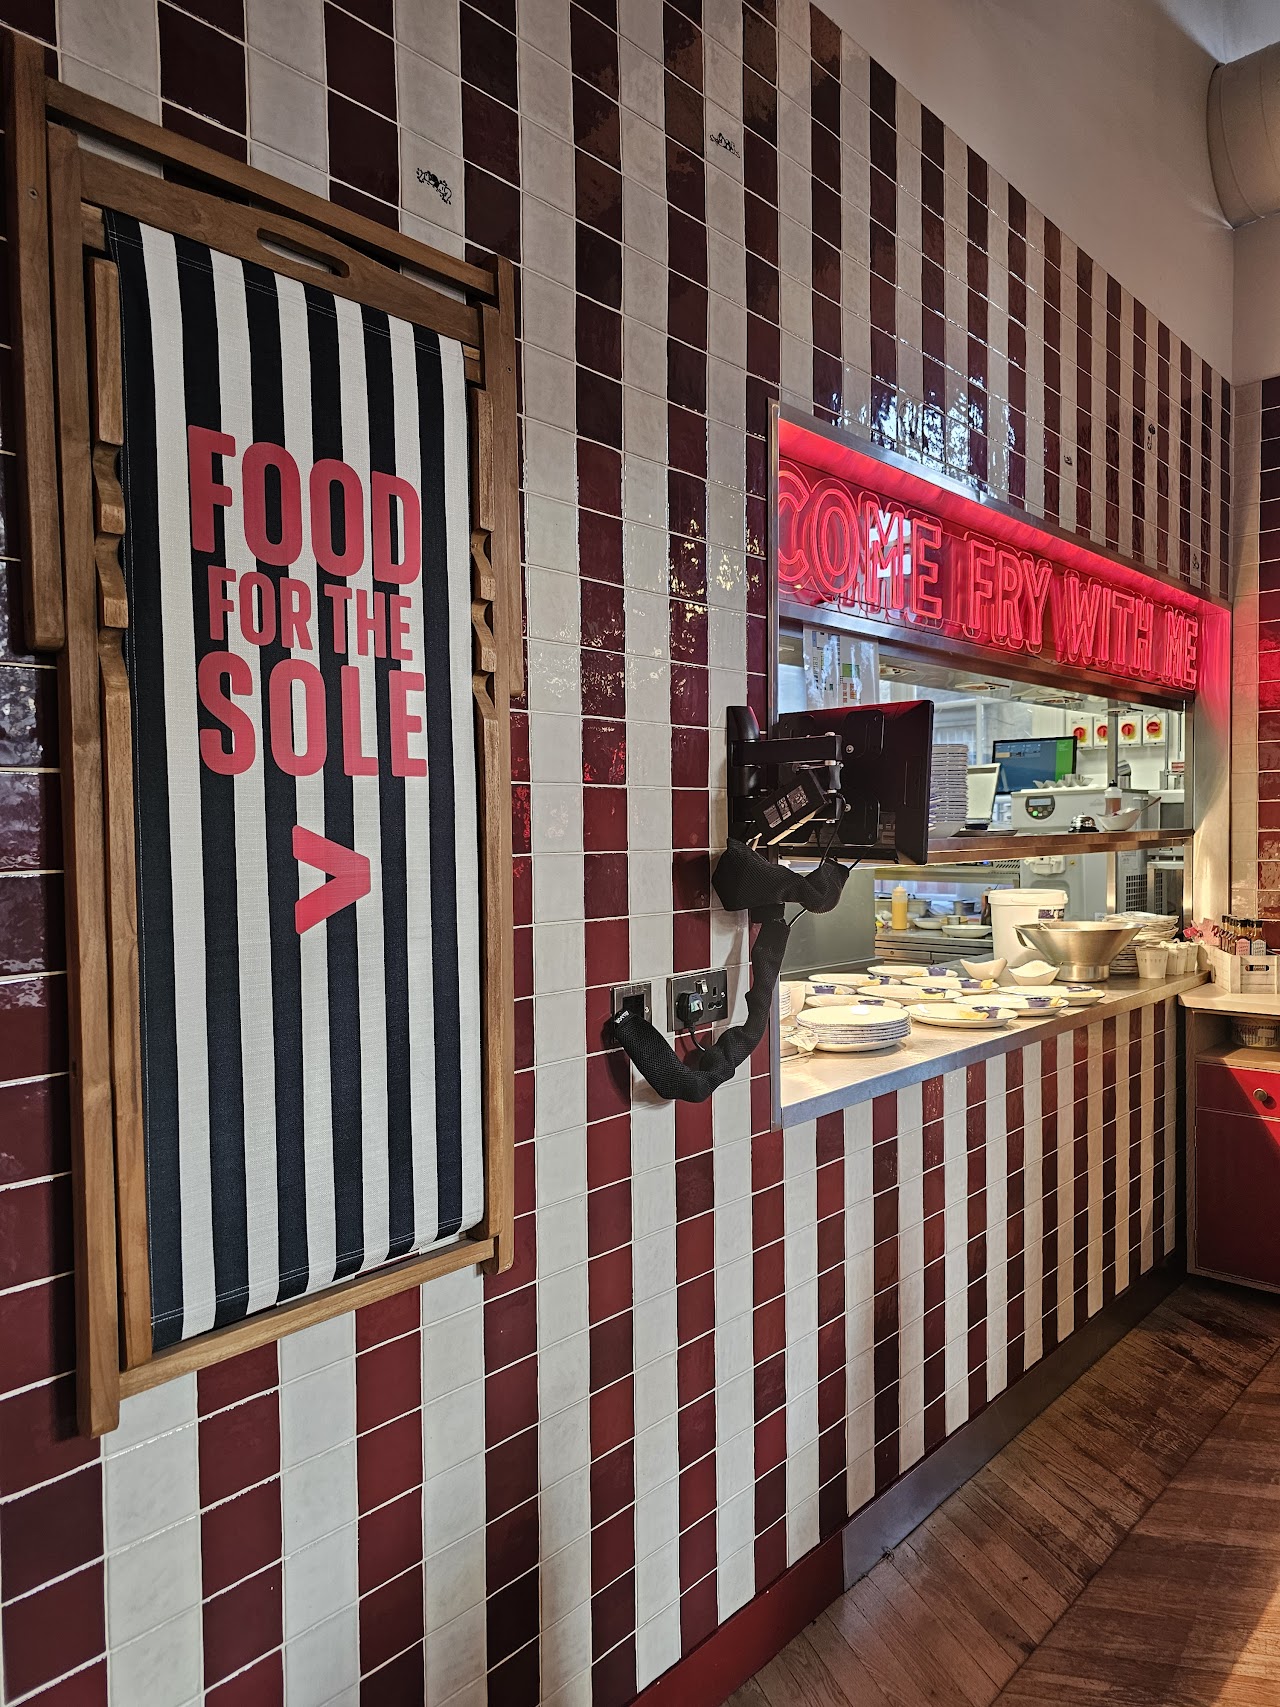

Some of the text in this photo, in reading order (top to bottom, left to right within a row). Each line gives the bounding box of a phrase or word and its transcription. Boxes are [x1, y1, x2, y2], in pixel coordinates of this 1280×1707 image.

[187, 425, 421, 584] FOOD
[207, 566, 413, 661] FOR THE
[778, 470, 1198, 685] COME FRY WITH ME
[198, 651, 428, 777] SOLE
